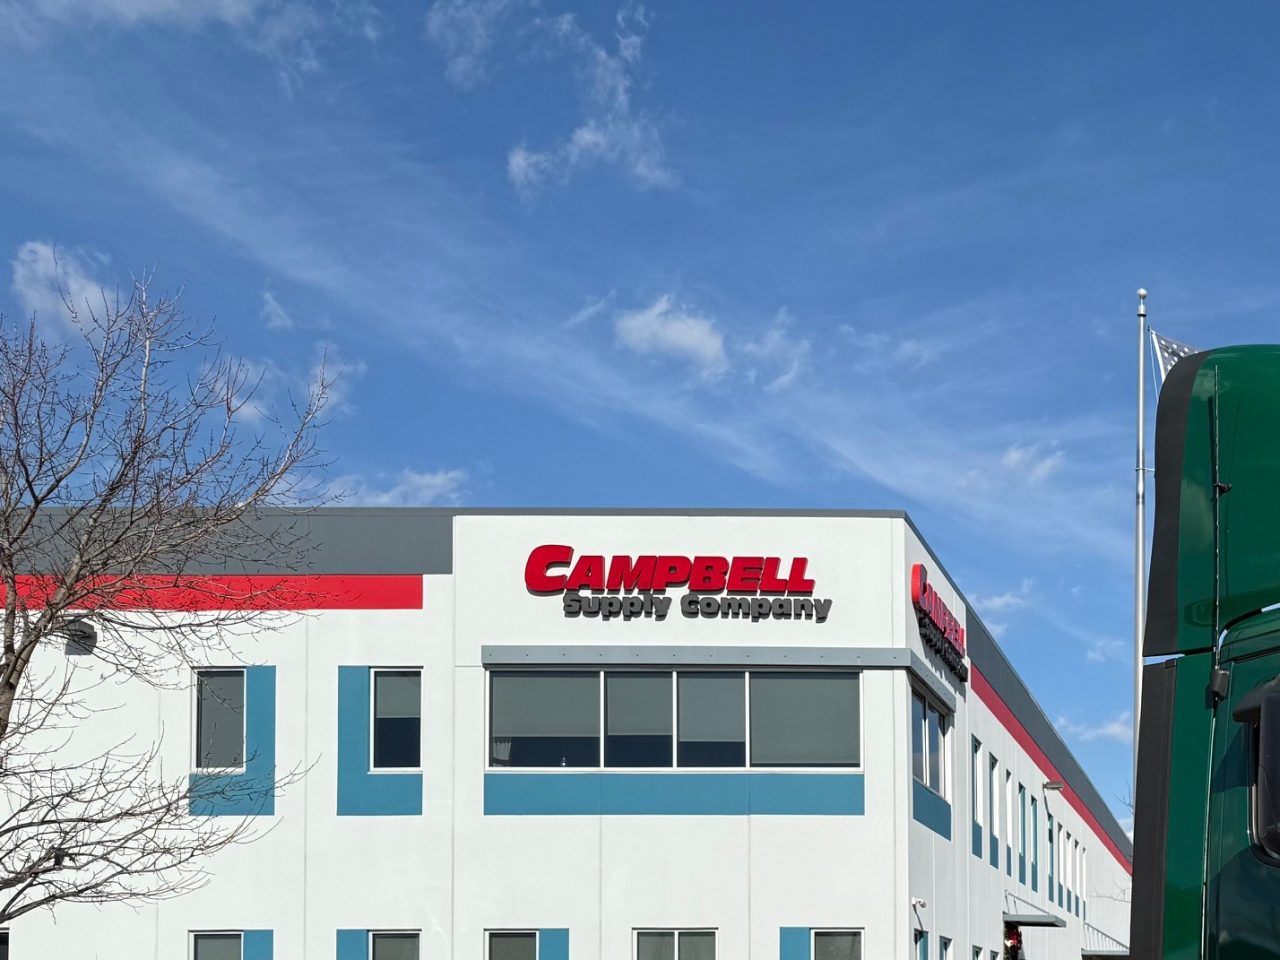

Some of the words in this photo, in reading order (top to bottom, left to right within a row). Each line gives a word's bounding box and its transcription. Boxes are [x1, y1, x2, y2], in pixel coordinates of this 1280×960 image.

[524, 544, 815, 597] CAMPBELL
[563, 592, 672, 622] Supply
[680, 592, 833, 624] Company
